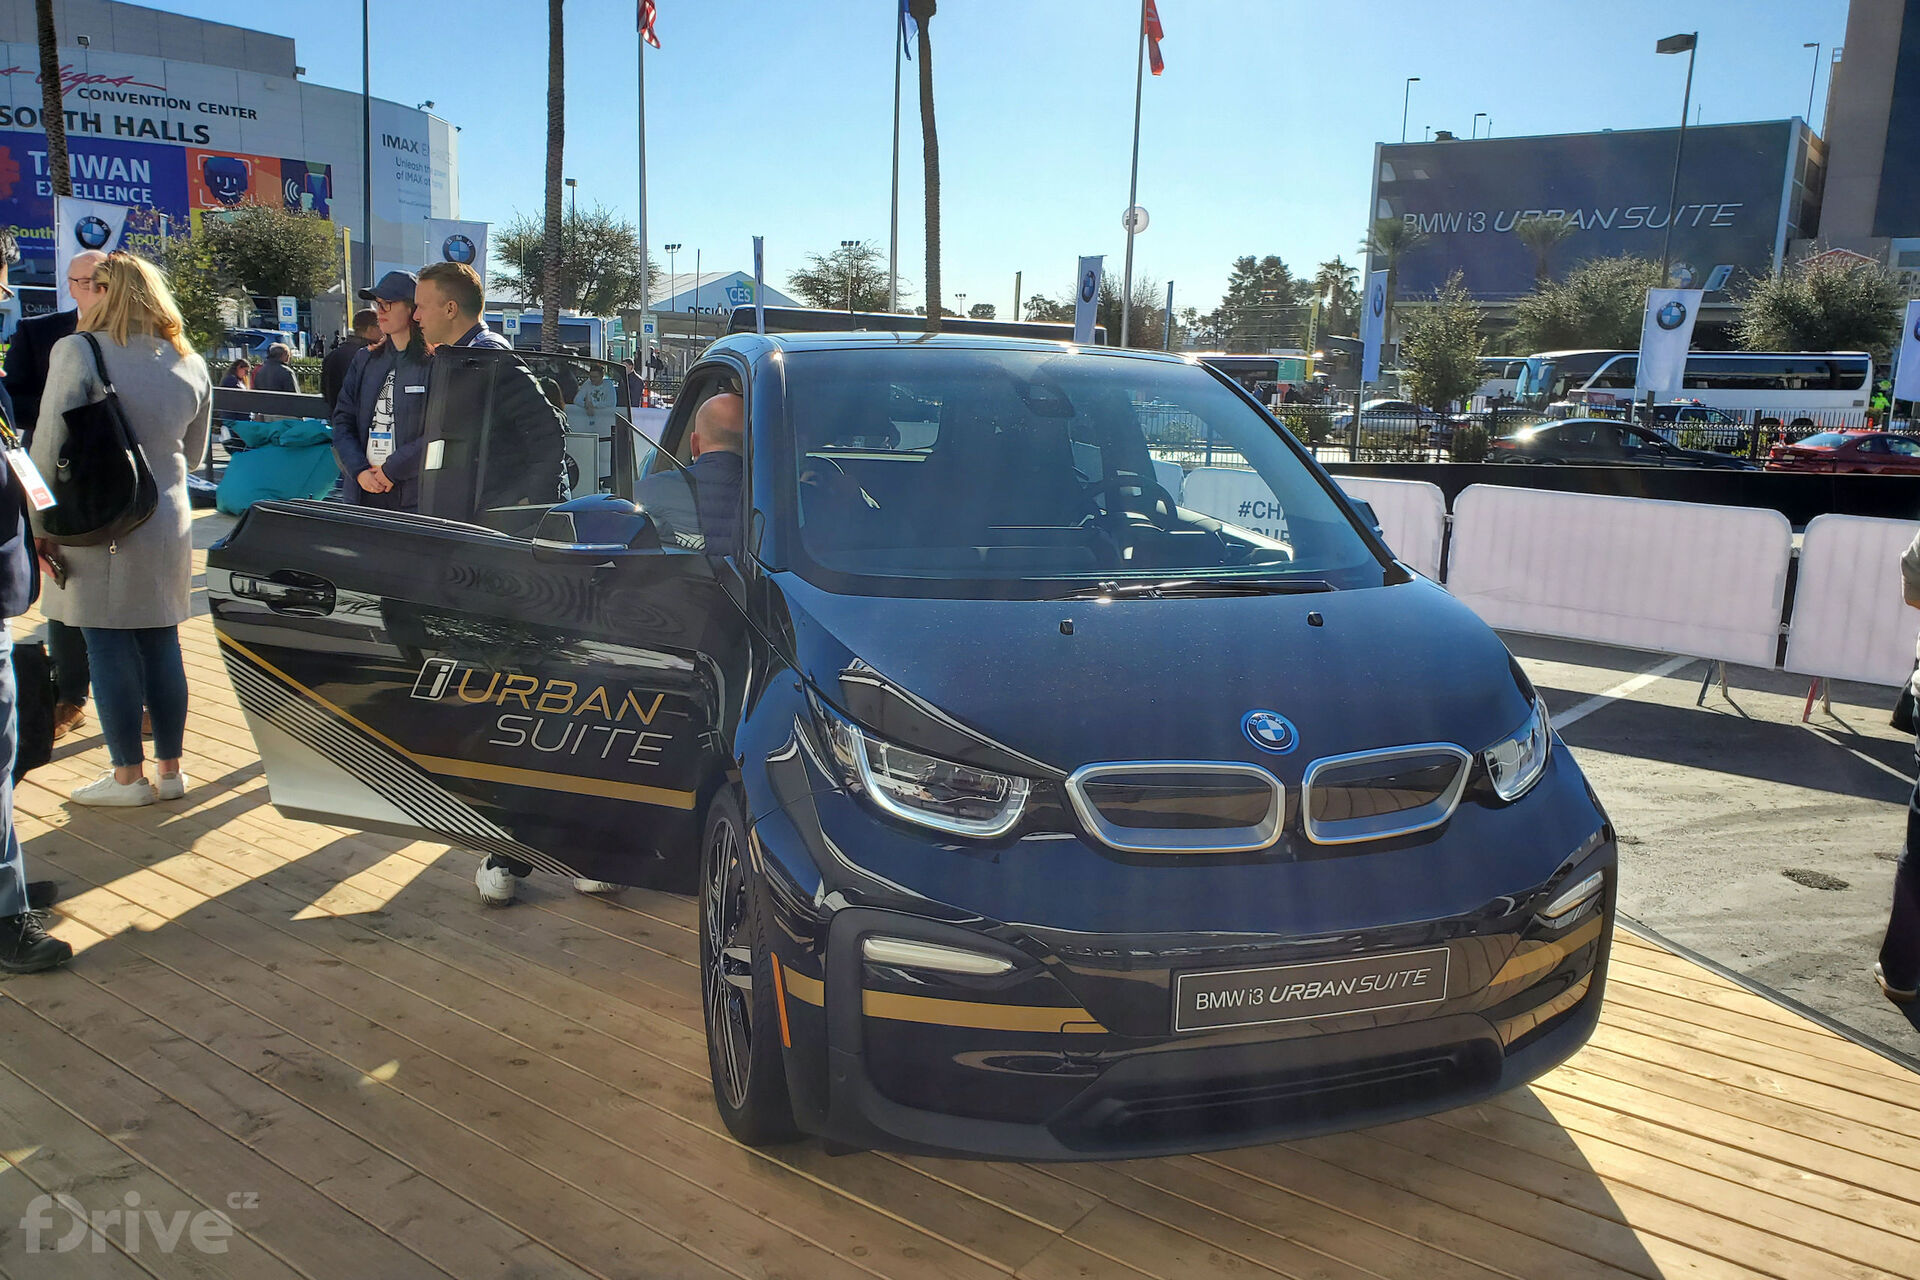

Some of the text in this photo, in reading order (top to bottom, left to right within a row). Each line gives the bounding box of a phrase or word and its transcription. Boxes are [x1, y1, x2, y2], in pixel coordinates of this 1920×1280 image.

[35, 64, 167, 97] egas
[77, 87, 258, 120] CONVENTION CENTER
[114, 115, 211, 145] HALLS
[382, 133, 419, 154] IMAX
[28, 150, 150, 184] TIWAN
[36, 180, 152, 204] EXELLENCE
[9, 225, 55, 240] South
[1403, 212, 1463, 233] BMW
[1467, 211, 1486, 233] i3
[1617, 203, 1743, 229] SUITE
[729, 287, 751, 302] CES
[1238, 501, 1286, 520] #CH
[457, 669, 665, 725] URBAN
[489, 714, 673, 766] SUITE
[1196, 967, 1431, 1010] BMW i3 URBAN SUITE
